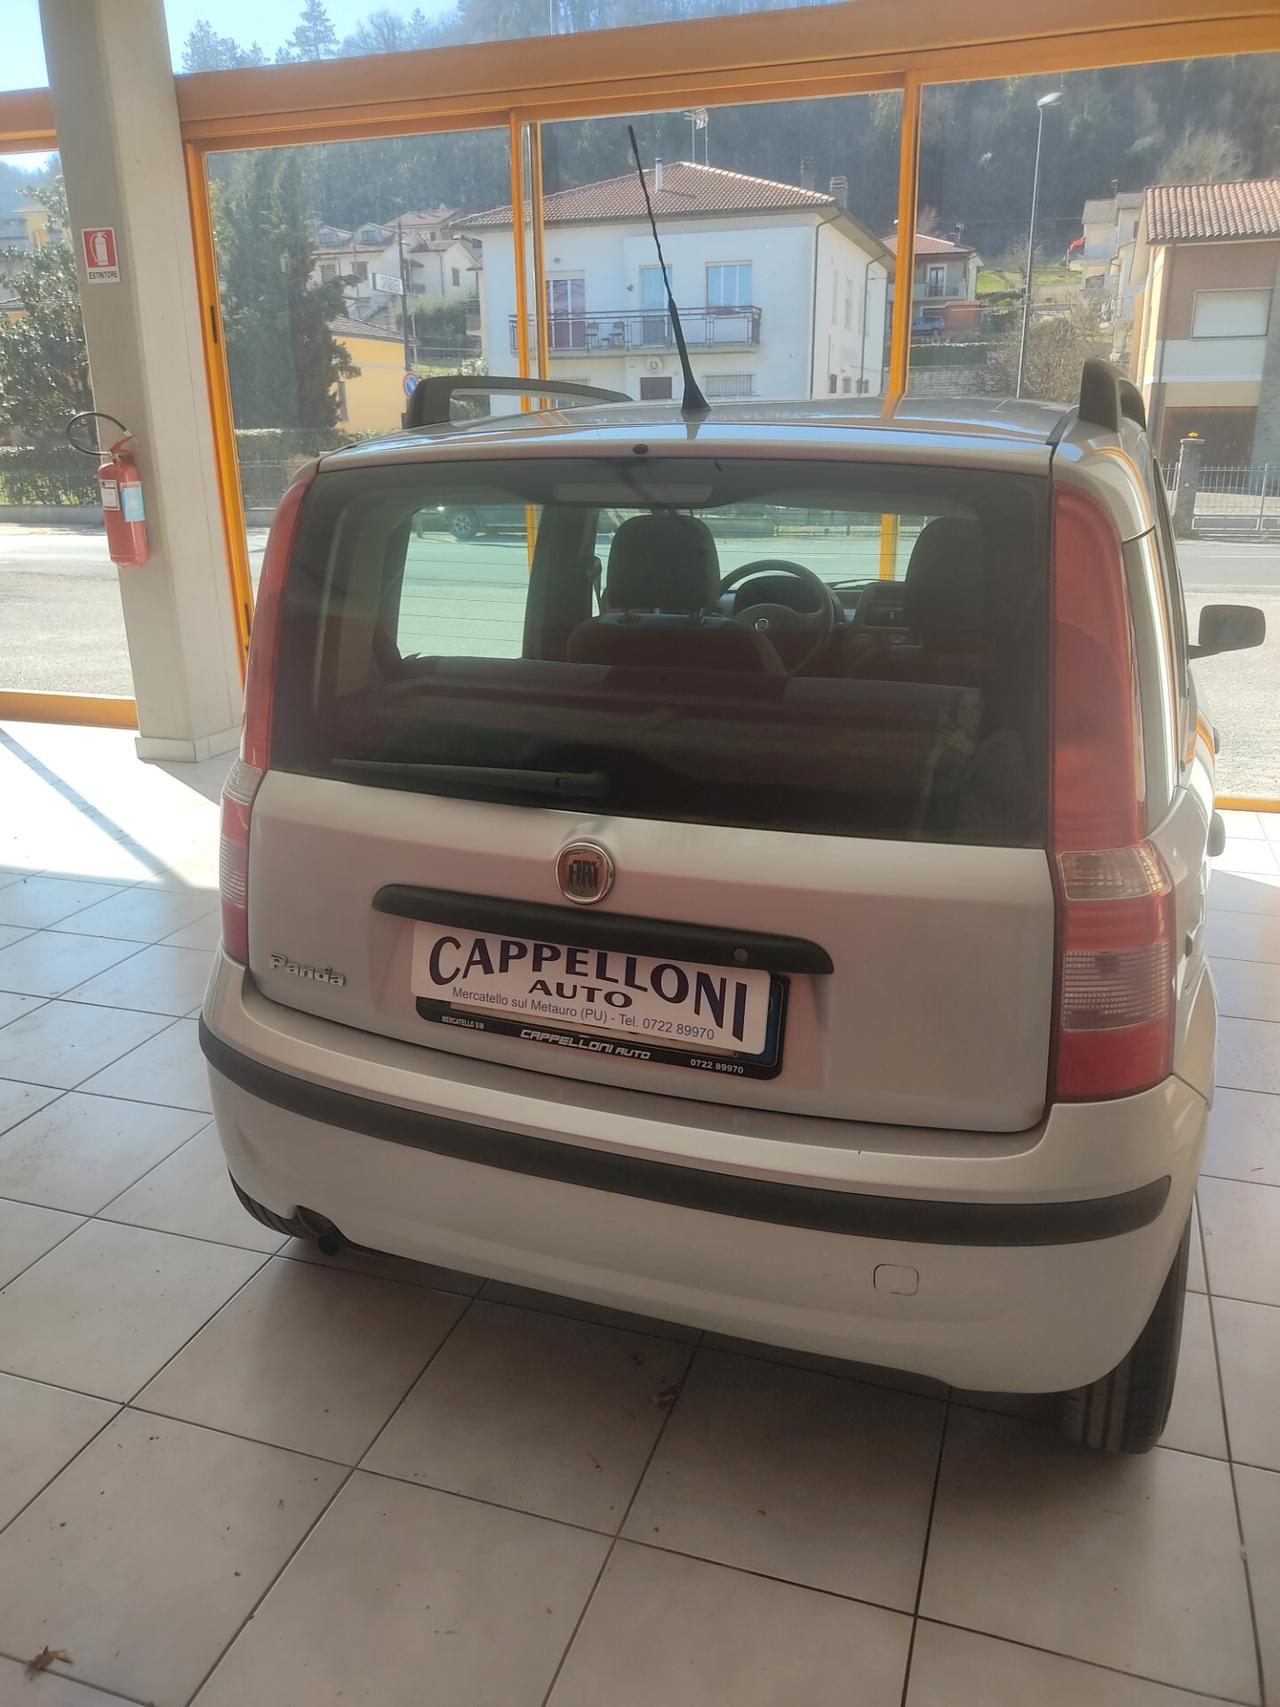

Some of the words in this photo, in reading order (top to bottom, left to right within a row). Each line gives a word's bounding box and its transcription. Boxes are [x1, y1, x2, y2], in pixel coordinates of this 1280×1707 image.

[88, 271, 118, 280] ESTINTORE
[269, 952, 346, 987] Panda
[429, 935, 747, 1042] CAPPELLONI
[528, 979, 633, 1008] AUTO
[441, 1015, 475, 1028] MERCATELLO
[452, 986, 508, 1006] Mercatello
[511, 999, 527, 1009] sul
[530, 999, 577, 1017] Metauro
[580, 1008, 608, 1023] (PU)
[619, 1013, 639, 1028] Tel.
[642, 1017, 672, 1033] 0722
[676, 1024, 714, 1041] 89970
[520, 1029, 614, 1053] CAPPELLONI
[615, 1047, 651, 1060] AUTO
[690, 1058, 713, 1069] 0722
[715, 1062, 744, 1074] 89970
